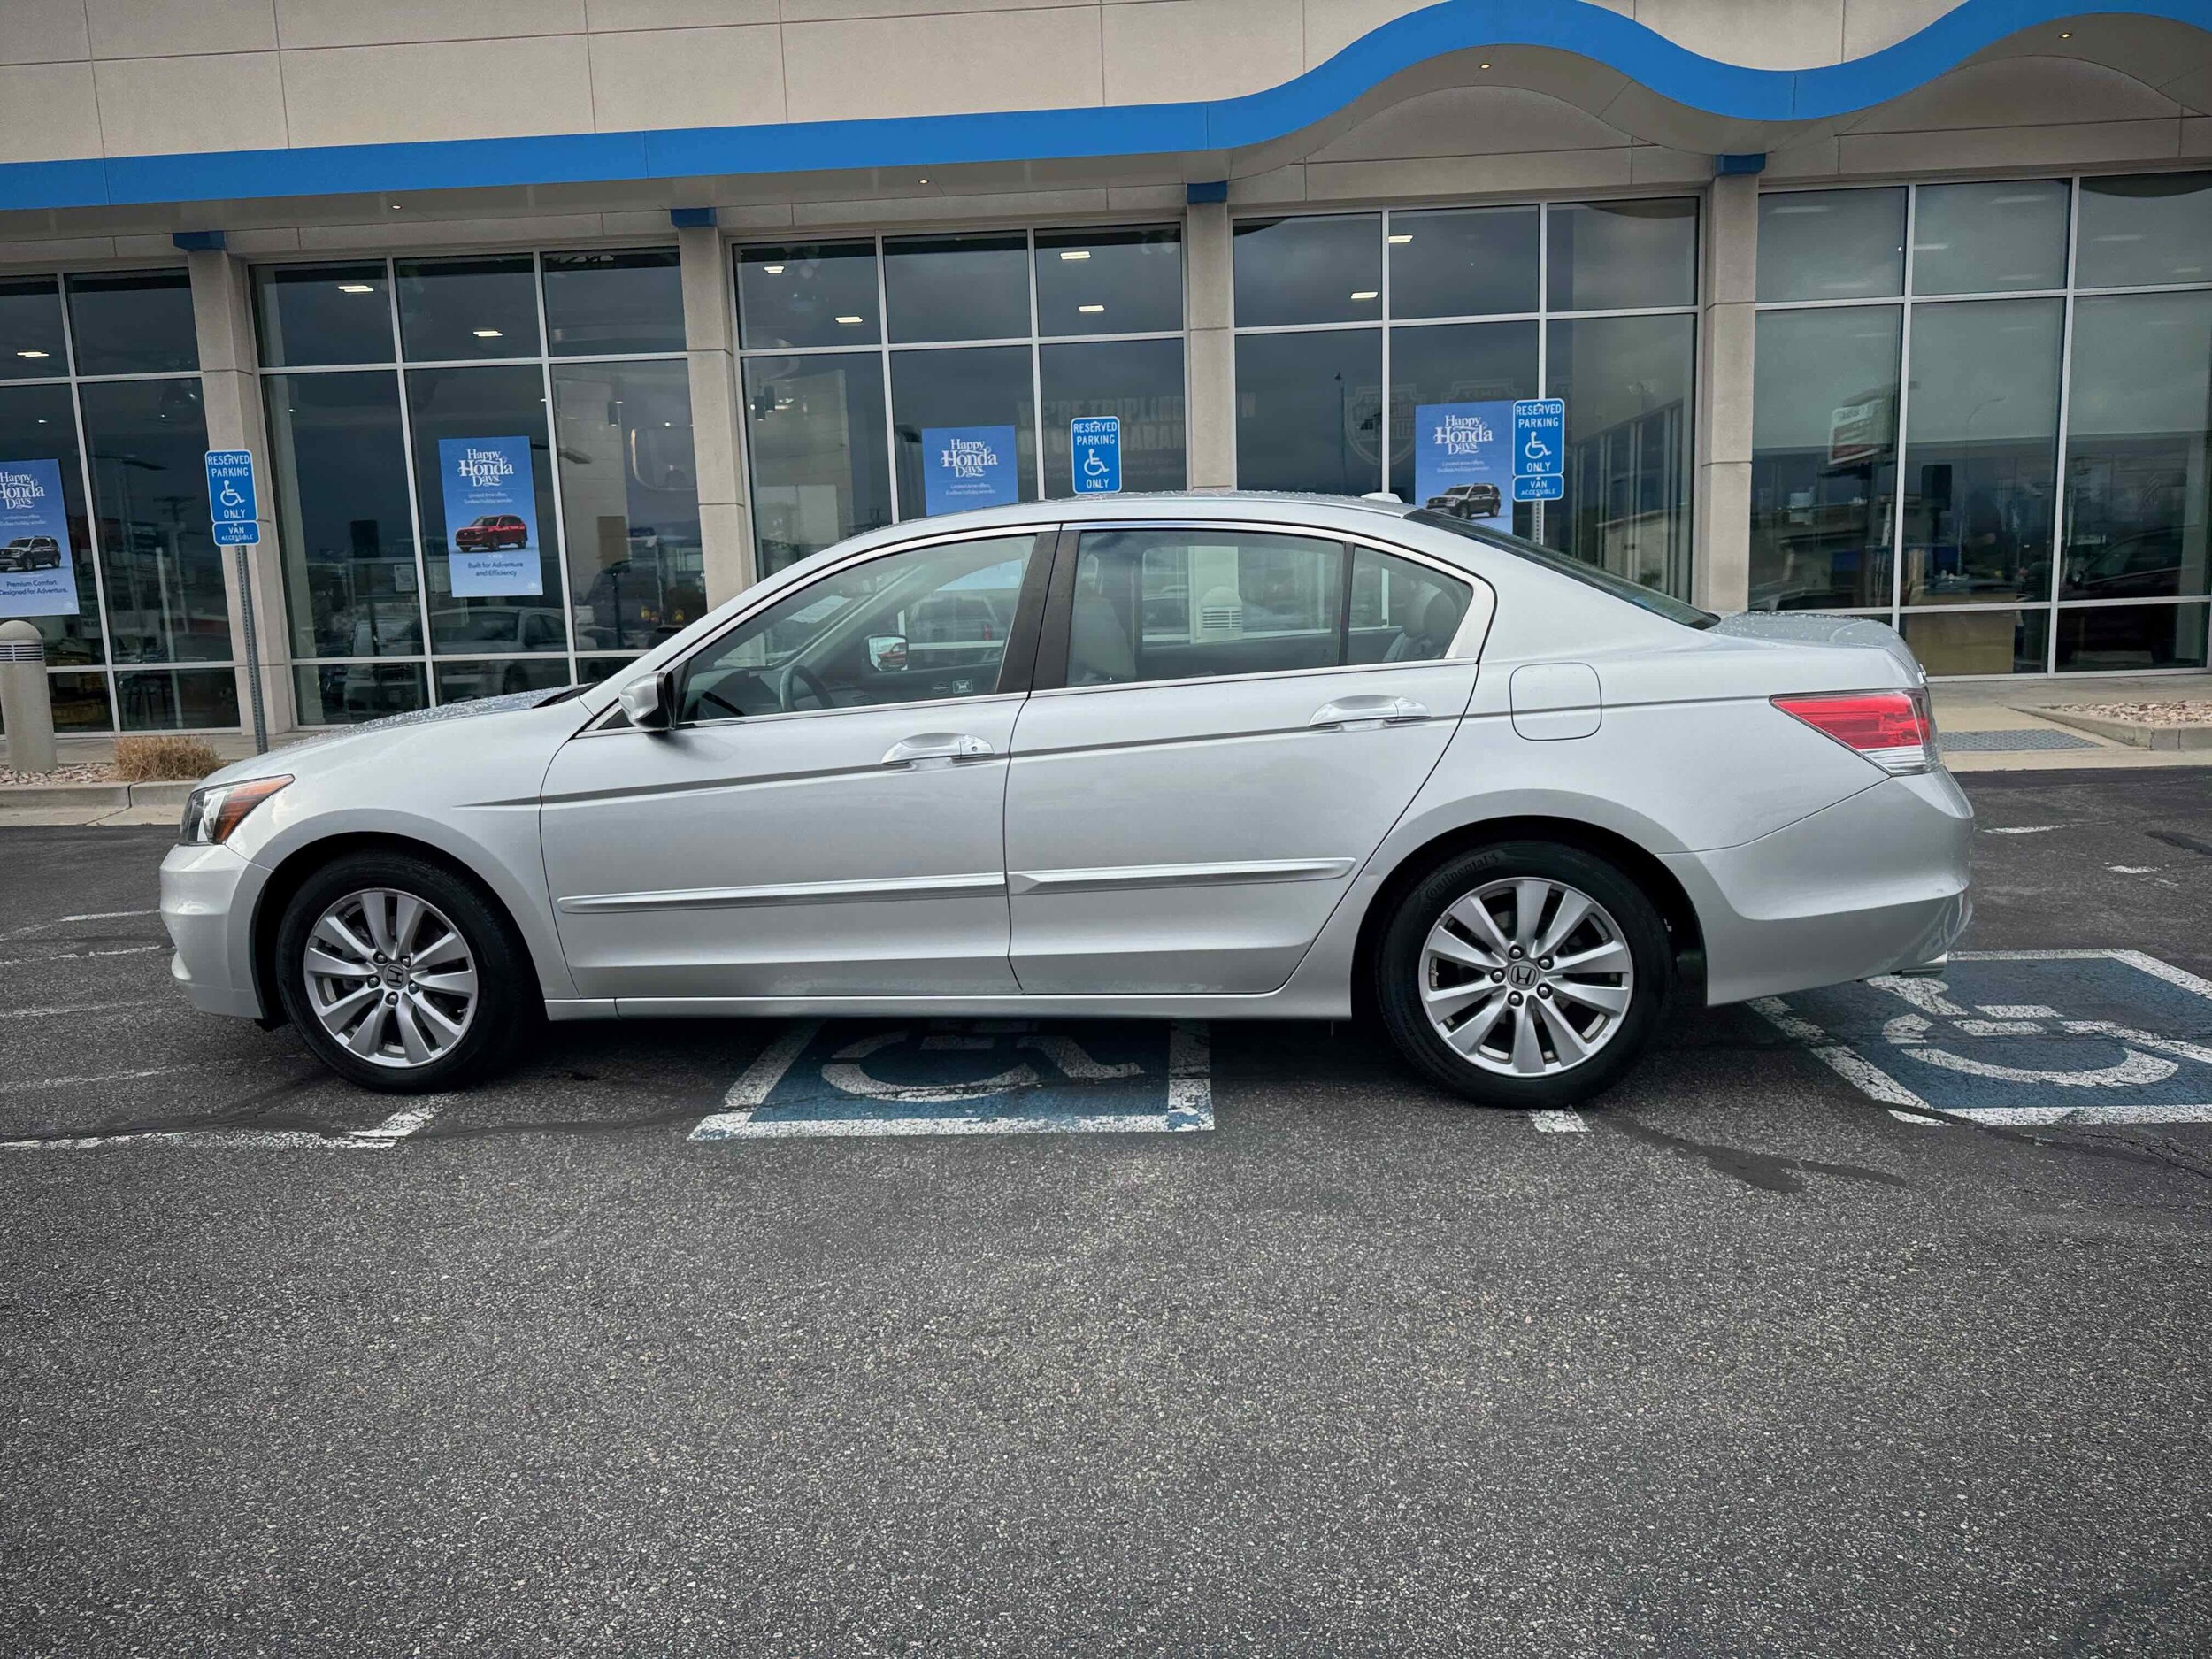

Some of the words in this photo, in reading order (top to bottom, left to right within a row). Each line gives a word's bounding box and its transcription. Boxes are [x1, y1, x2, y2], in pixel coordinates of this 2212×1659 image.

[1516, 404, 1562, 416] RESERVED
[1445, 414, 1482, 427] Happy
[1518, 418, 1559, 428] PARKING
[1073, 421, 1118, 434] RESERVED
[1433, 424, 1493, 444] Honda
[950, 438, 986, 451] Happy
[1077, 434, 1115, 446] PARKING
[467, 448, 502, 461] Happy
[1448, 442, 1480, 455] Days
[207, 454, 250, 465] RESERVED
[941, 448, 998, 467] Honda
[212, 467, 249, 478] PARKING
[457, 458, 514, 476] Honda
[956, 465, 986, 478] Days
[1526, 462, 1551, 472] ONLY
[472, 474, 503, 487] Days
[1086, 478, 1110, 489] ONLY
[5, 497, 35, 510] Days
[223, 509, 246, 519] ONLY
[488, 569, 517, 578] Efficiency
[6, 580, 32, 588] Premium
